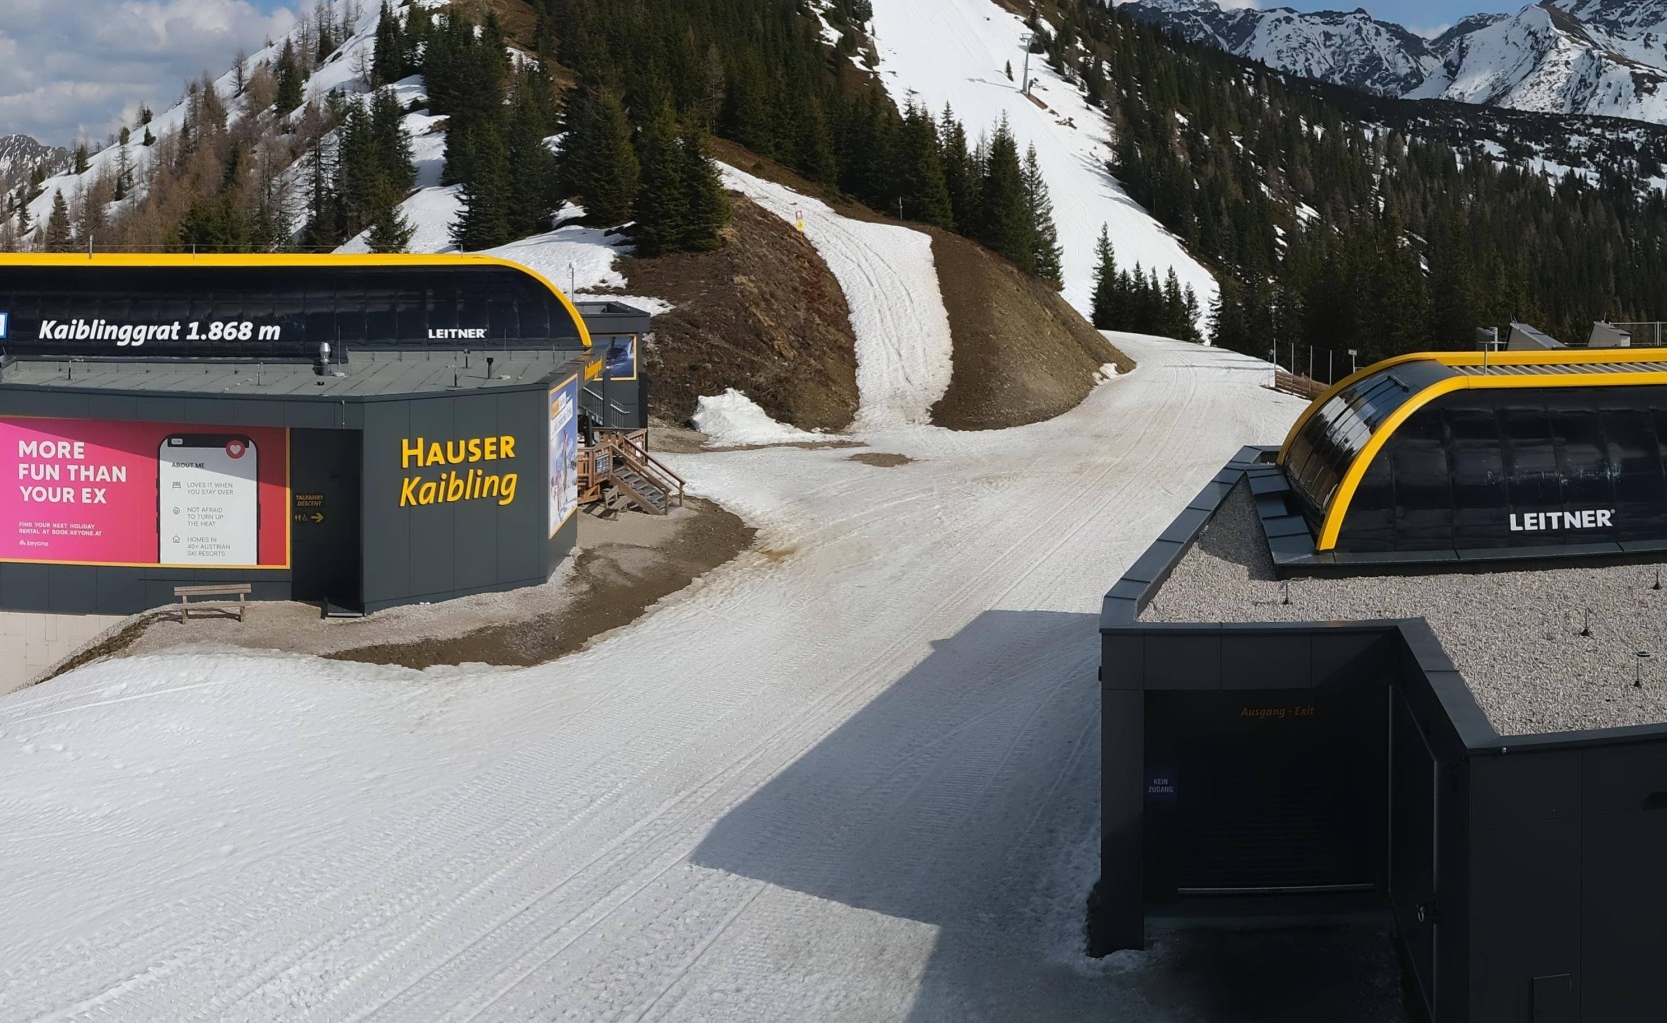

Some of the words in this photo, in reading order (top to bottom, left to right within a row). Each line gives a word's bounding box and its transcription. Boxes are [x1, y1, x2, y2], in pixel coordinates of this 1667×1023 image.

[39, 319, 180, 346] Kaiblinggrat
[186, 321, 252, 341] 1.868
[258, 323, 280, 340] m
[18, 440, 85, 459] MORE
[402, 435, 515, 468] HAUSER
[18, 463, 60, 481] FUN
[67, 465, 127, 482] THAN
[19, 485, 75, 503] YOUR
[81, 488, 107, 504] EX
[400, 469, 518, 506] Kaibling
[1240, 706, 1286, 719] Ausgang
[1294, 706, 1314, 716] Exit
